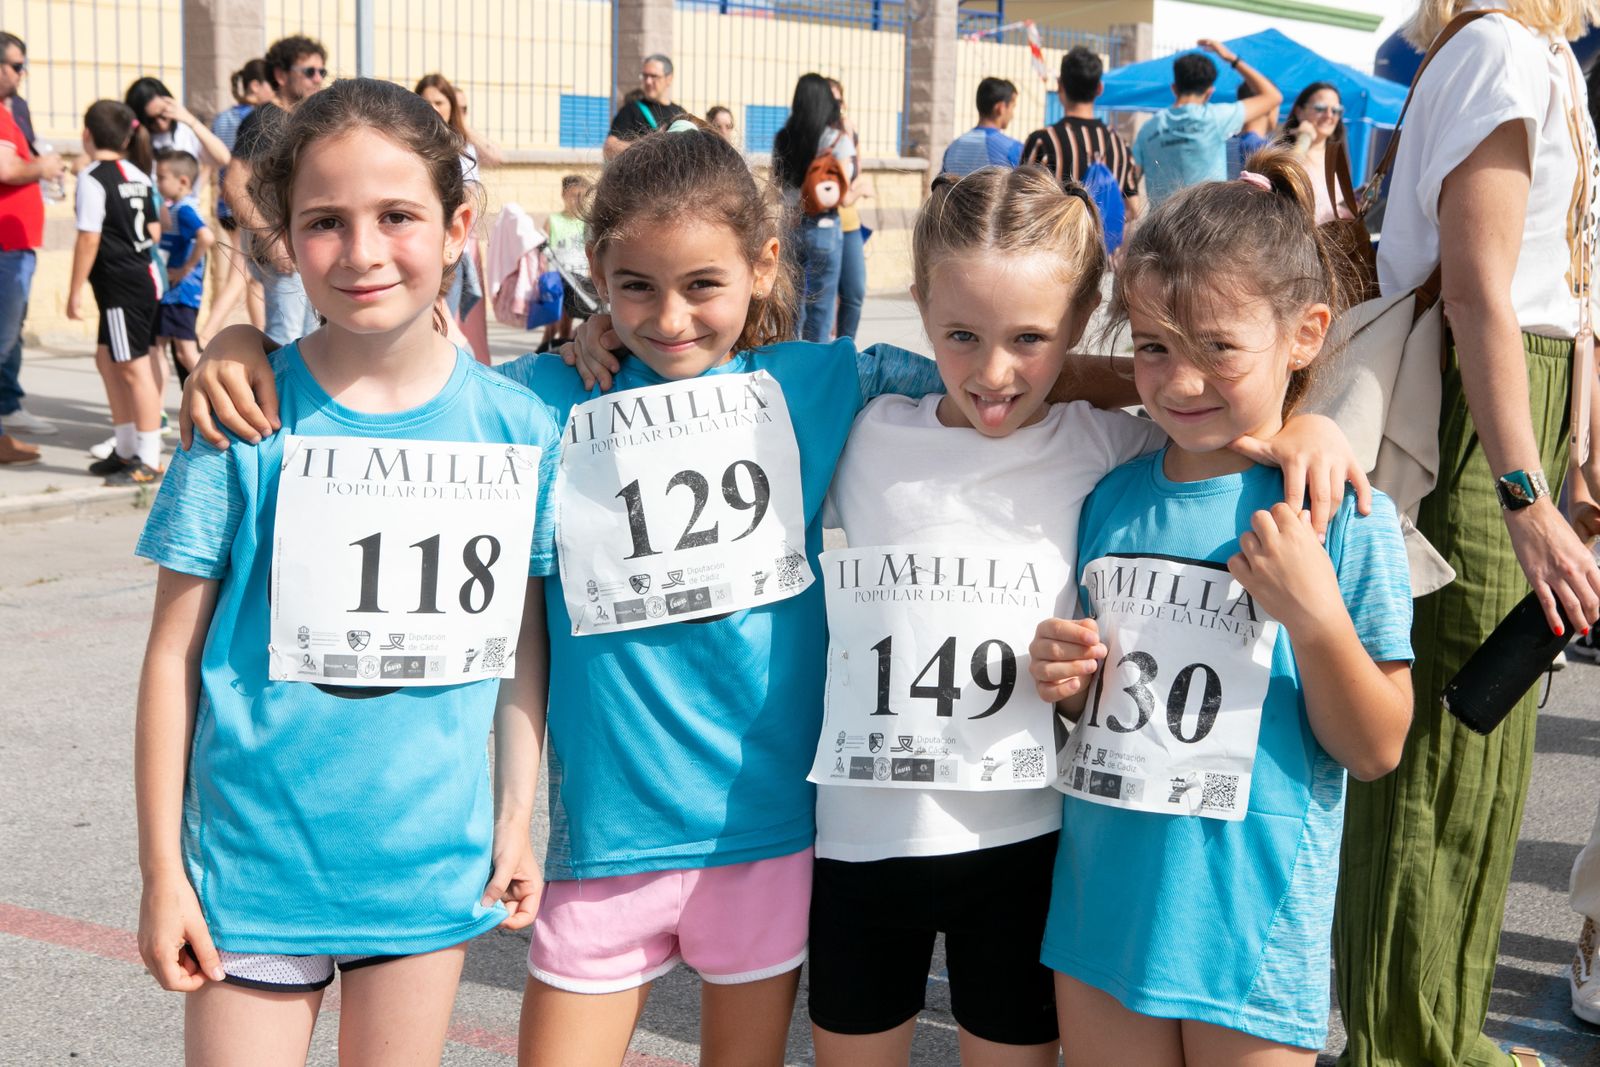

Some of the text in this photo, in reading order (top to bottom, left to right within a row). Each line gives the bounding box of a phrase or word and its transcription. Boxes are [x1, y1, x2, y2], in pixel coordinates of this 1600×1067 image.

[130, 198, 146, 242] 7
[568, 383, 771, 444] II MILLA
[591, 430, 664, 455] POPULAR
[669, 425, 694, 438] DE
[700, 419, 720, 433] LA
[299, 447, 523, 485] II MILLA
[326, 482, 416, 499] POPULAR
[423, 485, 448, 500] DE
[454, 486, 473, 500] LA
[615, 459, 771, 560] 129
[346, 532, 501, 614] 118
[837, 553, 1041, 593] II MILLA
[1107, 566, 1262, 623] MILLA
[855, 588, 924, 604] POPULAR
[931, 589, 955, 602] DE
[961, 591, 983, 604] LA
[1141, 603, 1165, 619] DE
[1172, 608, 1193, 625] LA
[870, 635, 1017, 720] 149
[1087, 650, 1223, 744] 130
